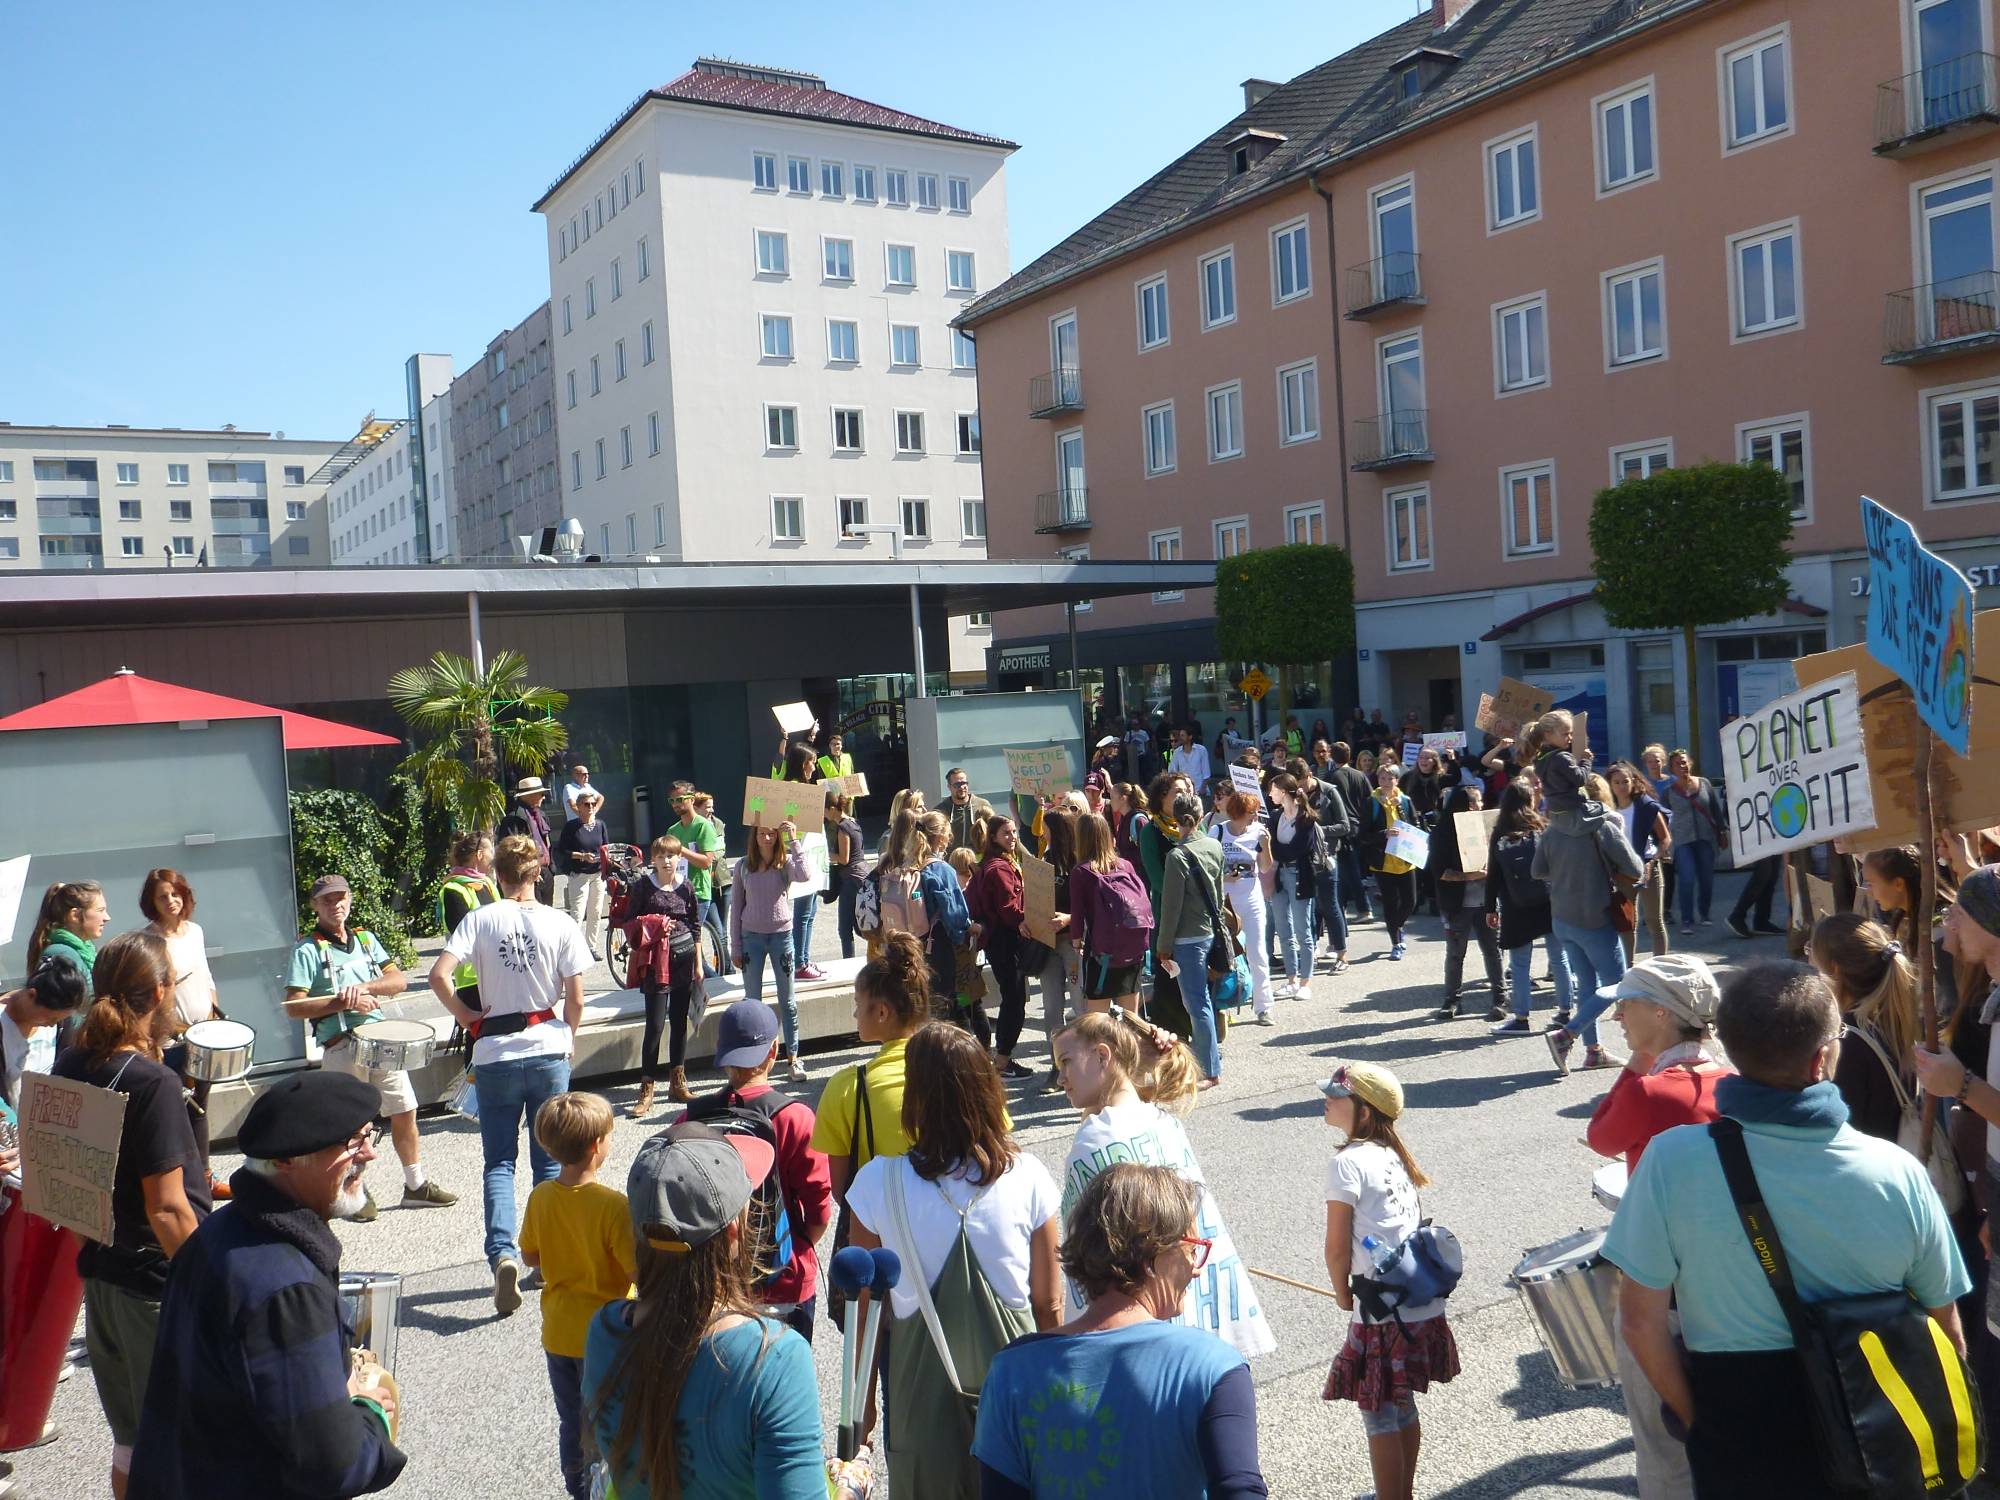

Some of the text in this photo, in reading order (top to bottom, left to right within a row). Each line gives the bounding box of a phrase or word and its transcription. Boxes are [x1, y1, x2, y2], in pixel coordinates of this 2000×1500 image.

[1000, 655, 1050, 671] APOTHEKE
[868, 703, 890, 715] CITY
[1736, 688, 1840, 784] PLANET
[1010, 763, 1052, 776] WORLD
[1768, 759, 1801, 787] OVER
[1736, 763, 1860, 856] PROFIT
[30, 1082, 83, 1129] FREIER
[1753, 1236, 1777, 1274] villach
[1046, 1424, 1088, 1454] FOR
